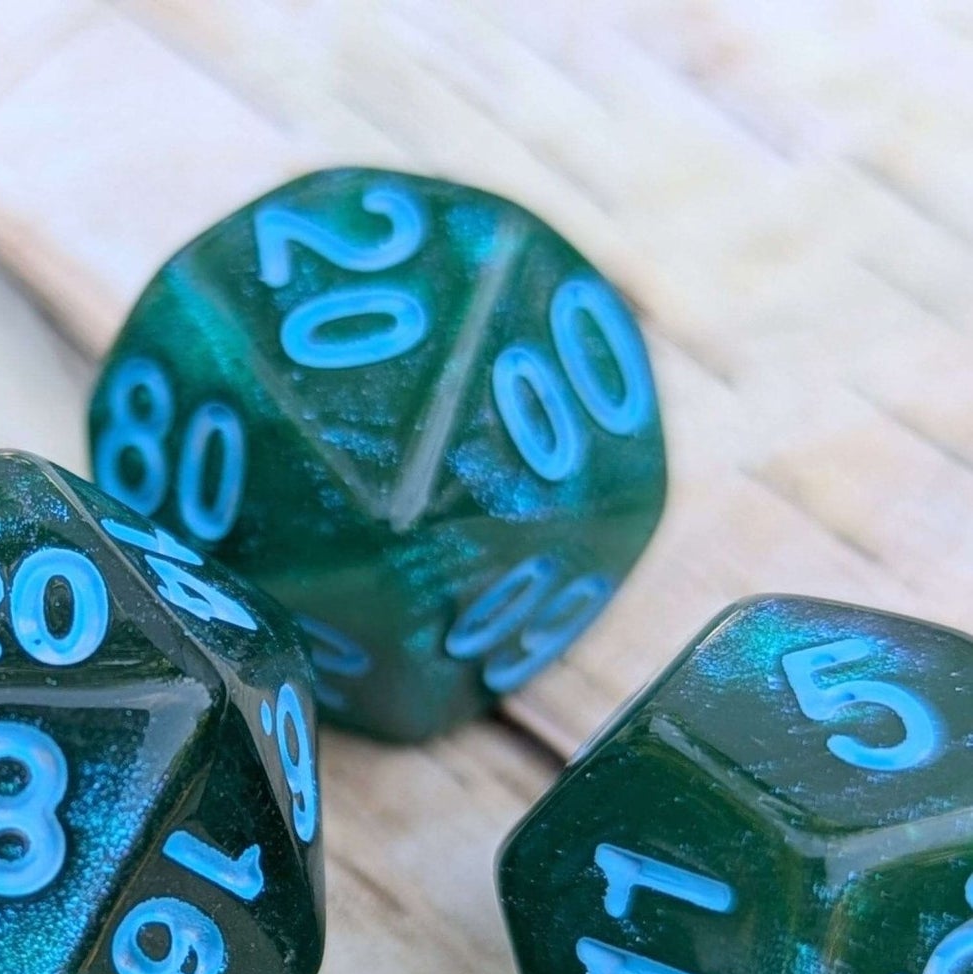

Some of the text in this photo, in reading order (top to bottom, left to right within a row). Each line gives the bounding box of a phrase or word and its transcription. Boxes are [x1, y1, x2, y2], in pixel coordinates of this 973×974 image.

[256, 185, 427, 369] 20
[96, 356, 246, 542] 80
[492, 278, 654, 482] 00
[100, 517, 258, 631] 14
[781, 637, 937, 772] 5
